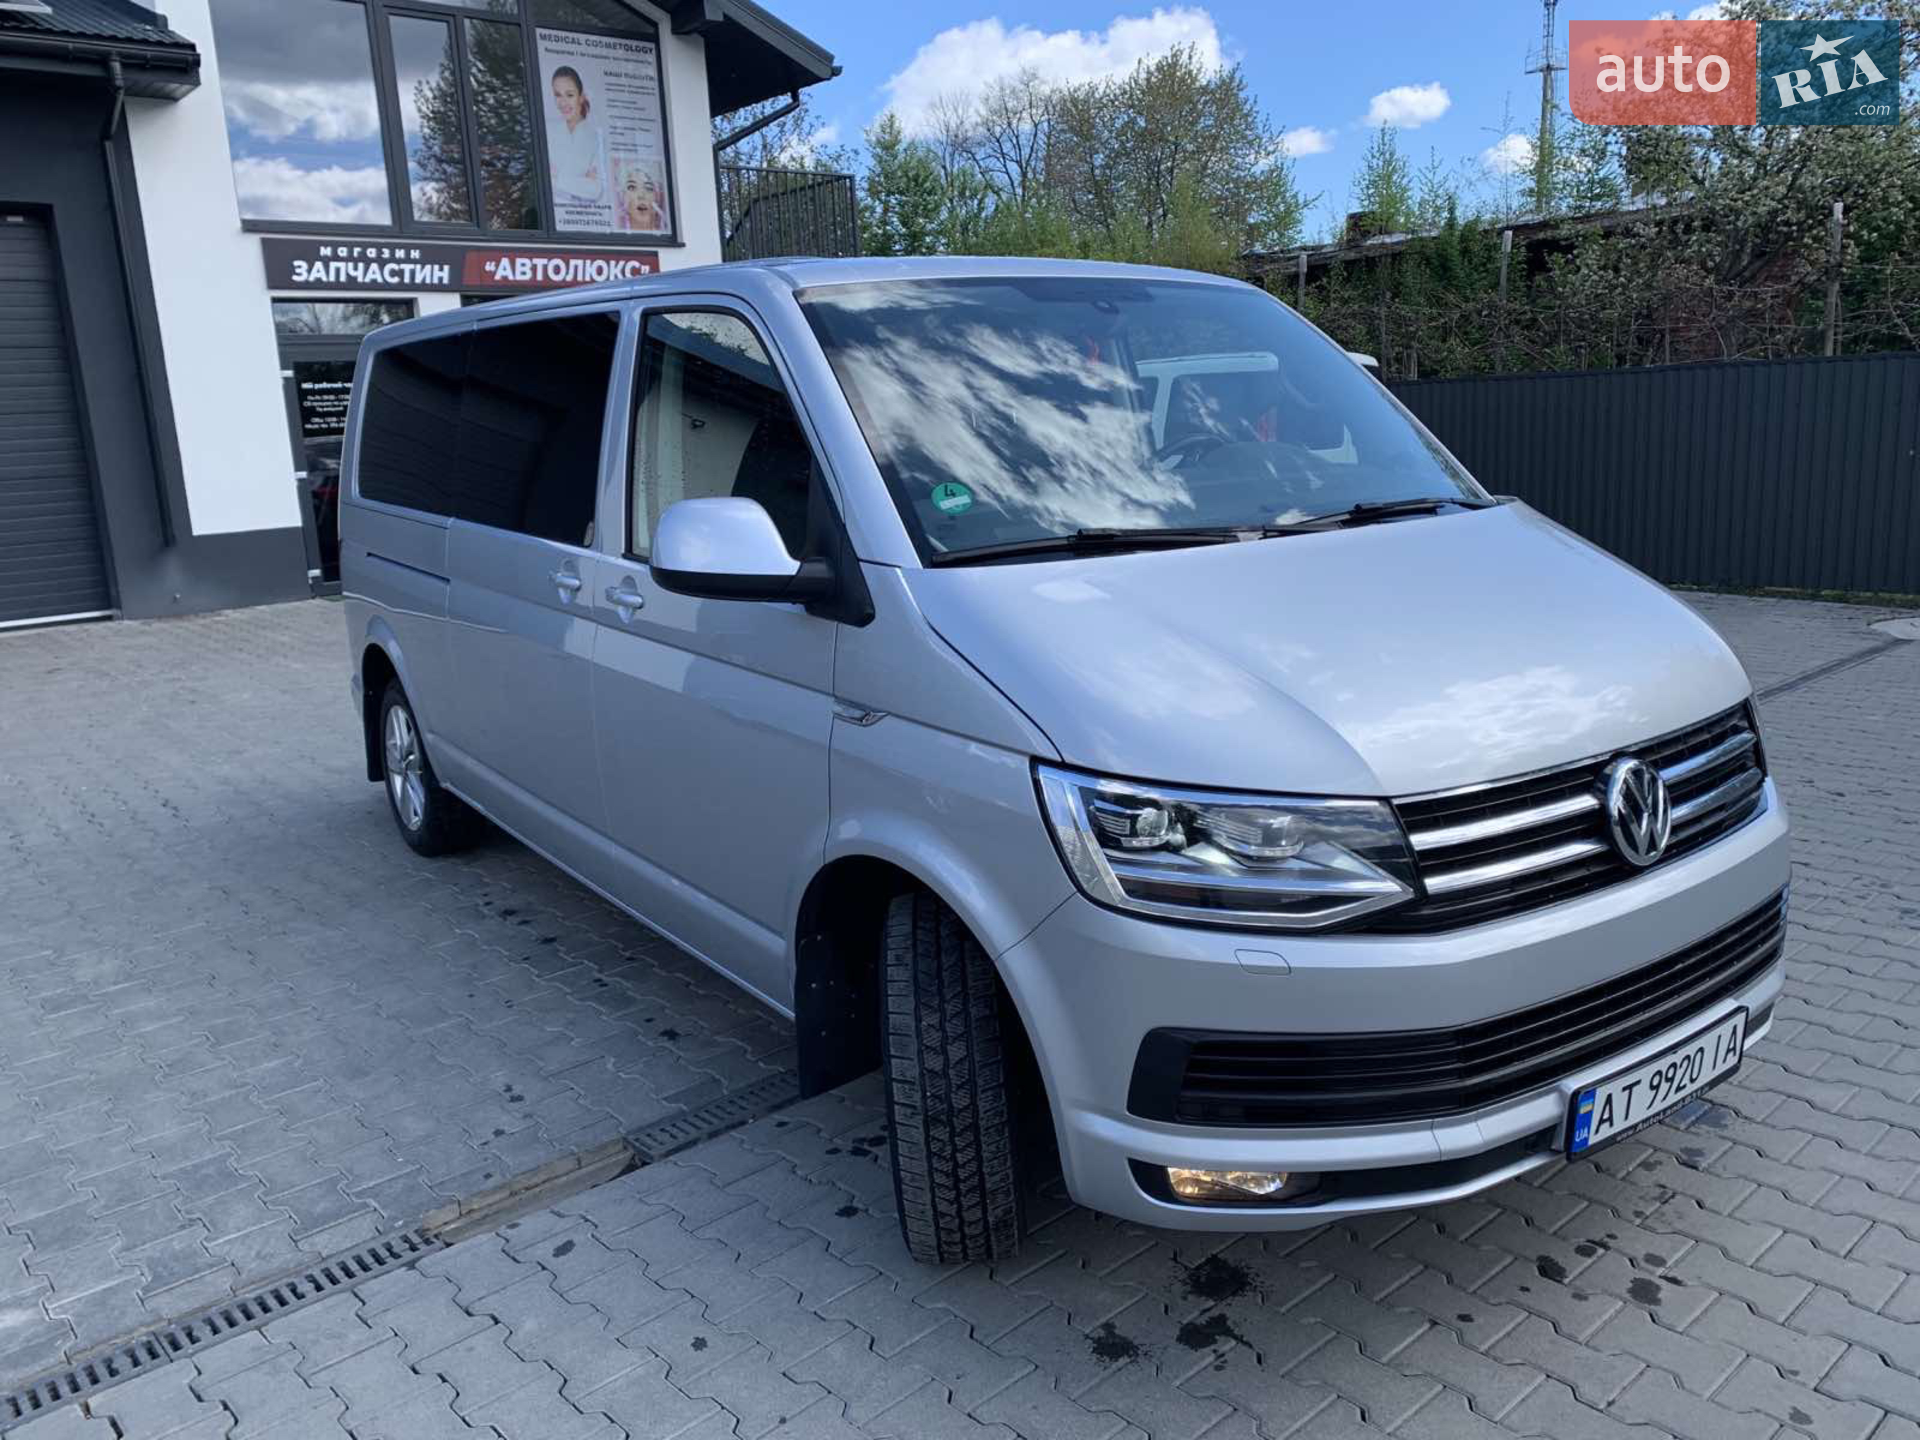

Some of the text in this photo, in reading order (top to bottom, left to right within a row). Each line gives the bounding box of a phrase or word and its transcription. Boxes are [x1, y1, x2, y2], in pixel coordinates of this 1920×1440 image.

[539, 31, 655, 55] MEDICAL COSMETOLOGY
[319, 245, 421, 259] магазин
[292, 260, 450, 284] ЗАПЧАСТИН
[1593, 1078, 1642, 1136] AT
[1646, 1045, 1705, 1111] 9920
[1712, 1023, 1738, 1072] IA
[1574, 1127, 1589, 1142] UA
